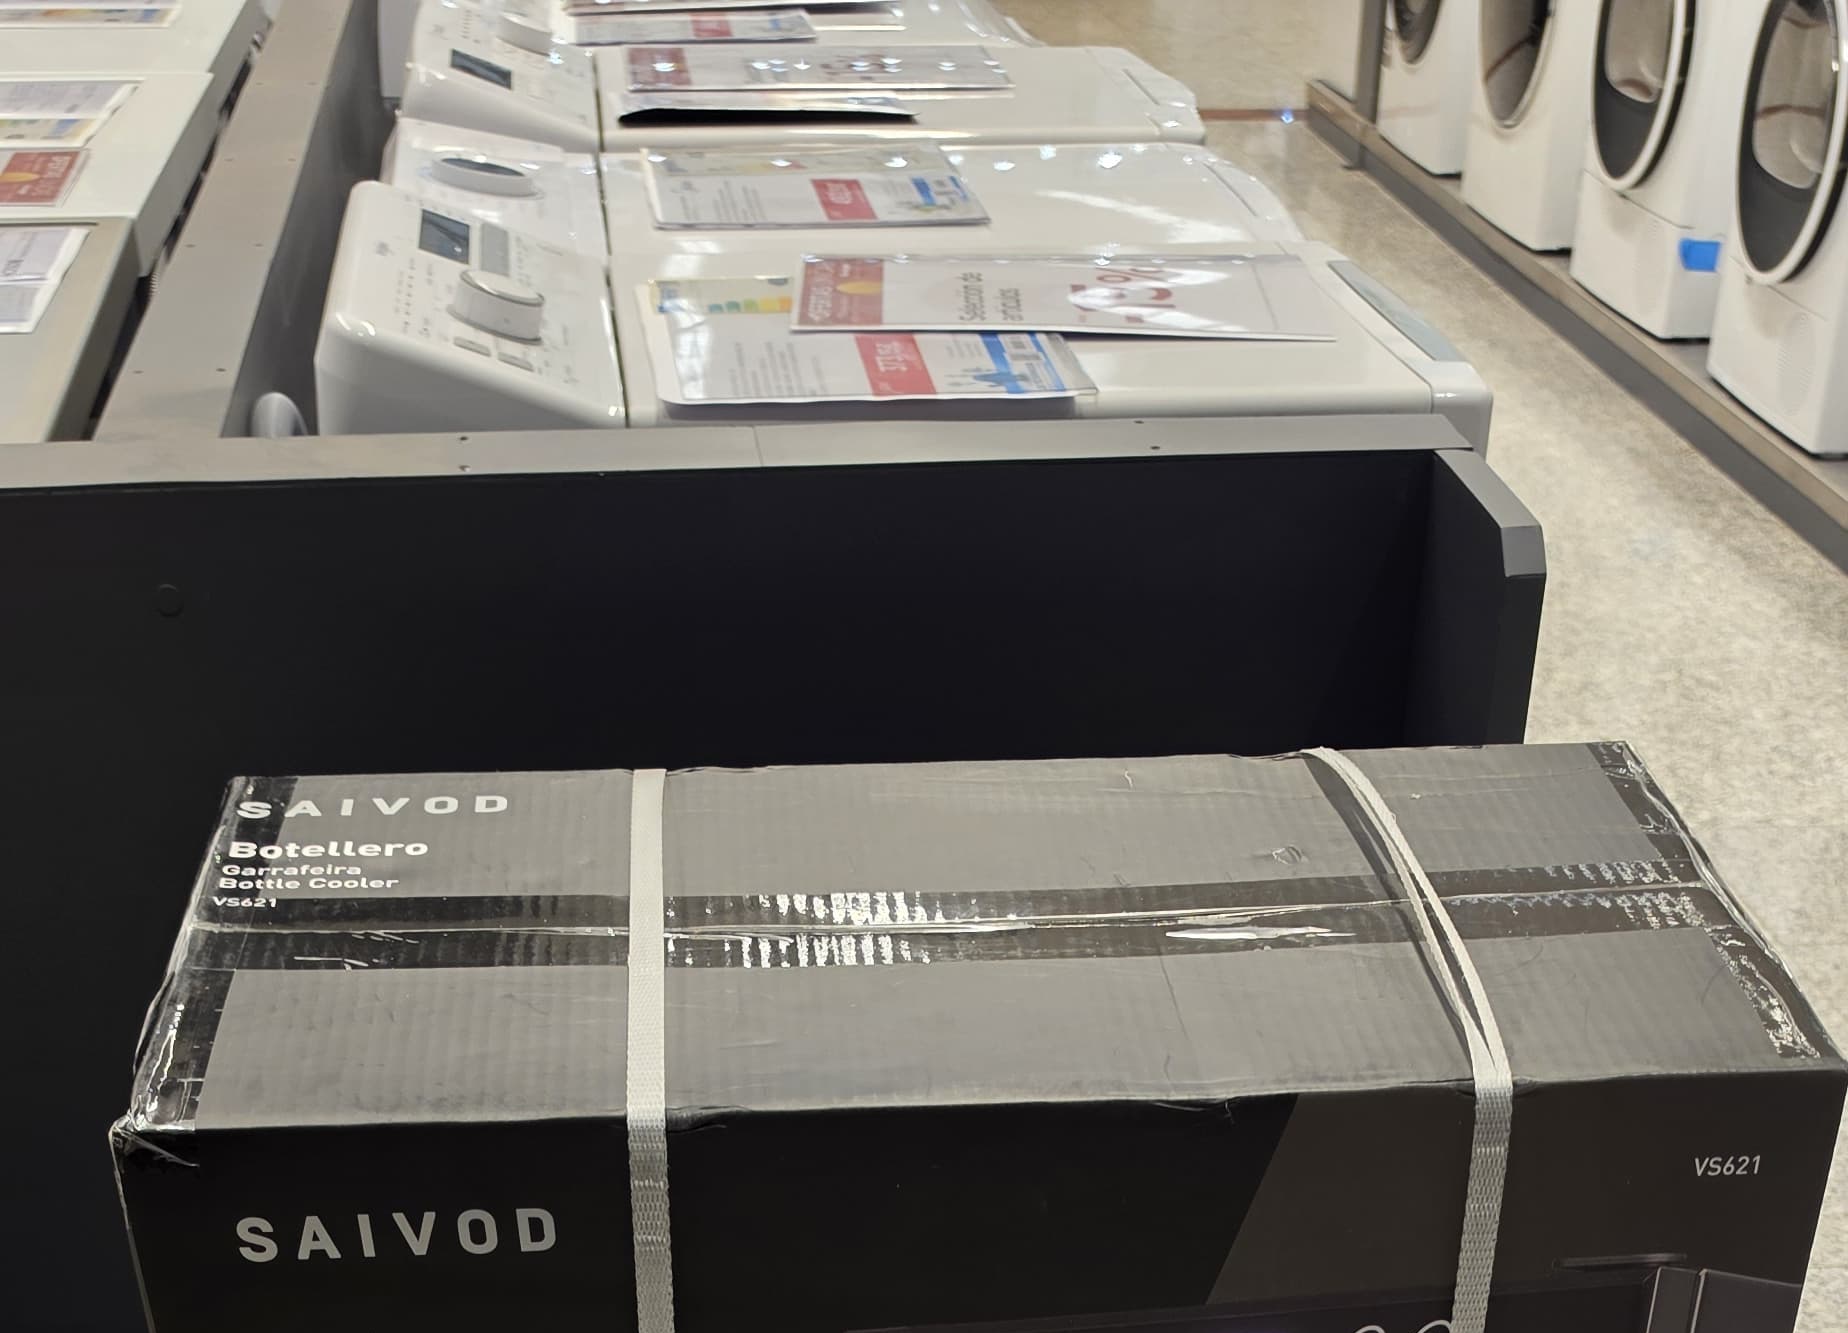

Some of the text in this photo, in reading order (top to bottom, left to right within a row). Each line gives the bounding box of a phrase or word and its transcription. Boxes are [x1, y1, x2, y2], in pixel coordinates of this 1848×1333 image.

[237, 796, 507, 818] SAIVOD
[229, 841, 428, 859] Botellero
[223, 864, 361, 875] Garrafeira
[219, 878, 398, 889] Bottle Cooler
[212, 895, 276, 907] VS621
[1695, 1155, 1760, 1176] VS621
[237, 1208, 556, 1262] SAIVOD
